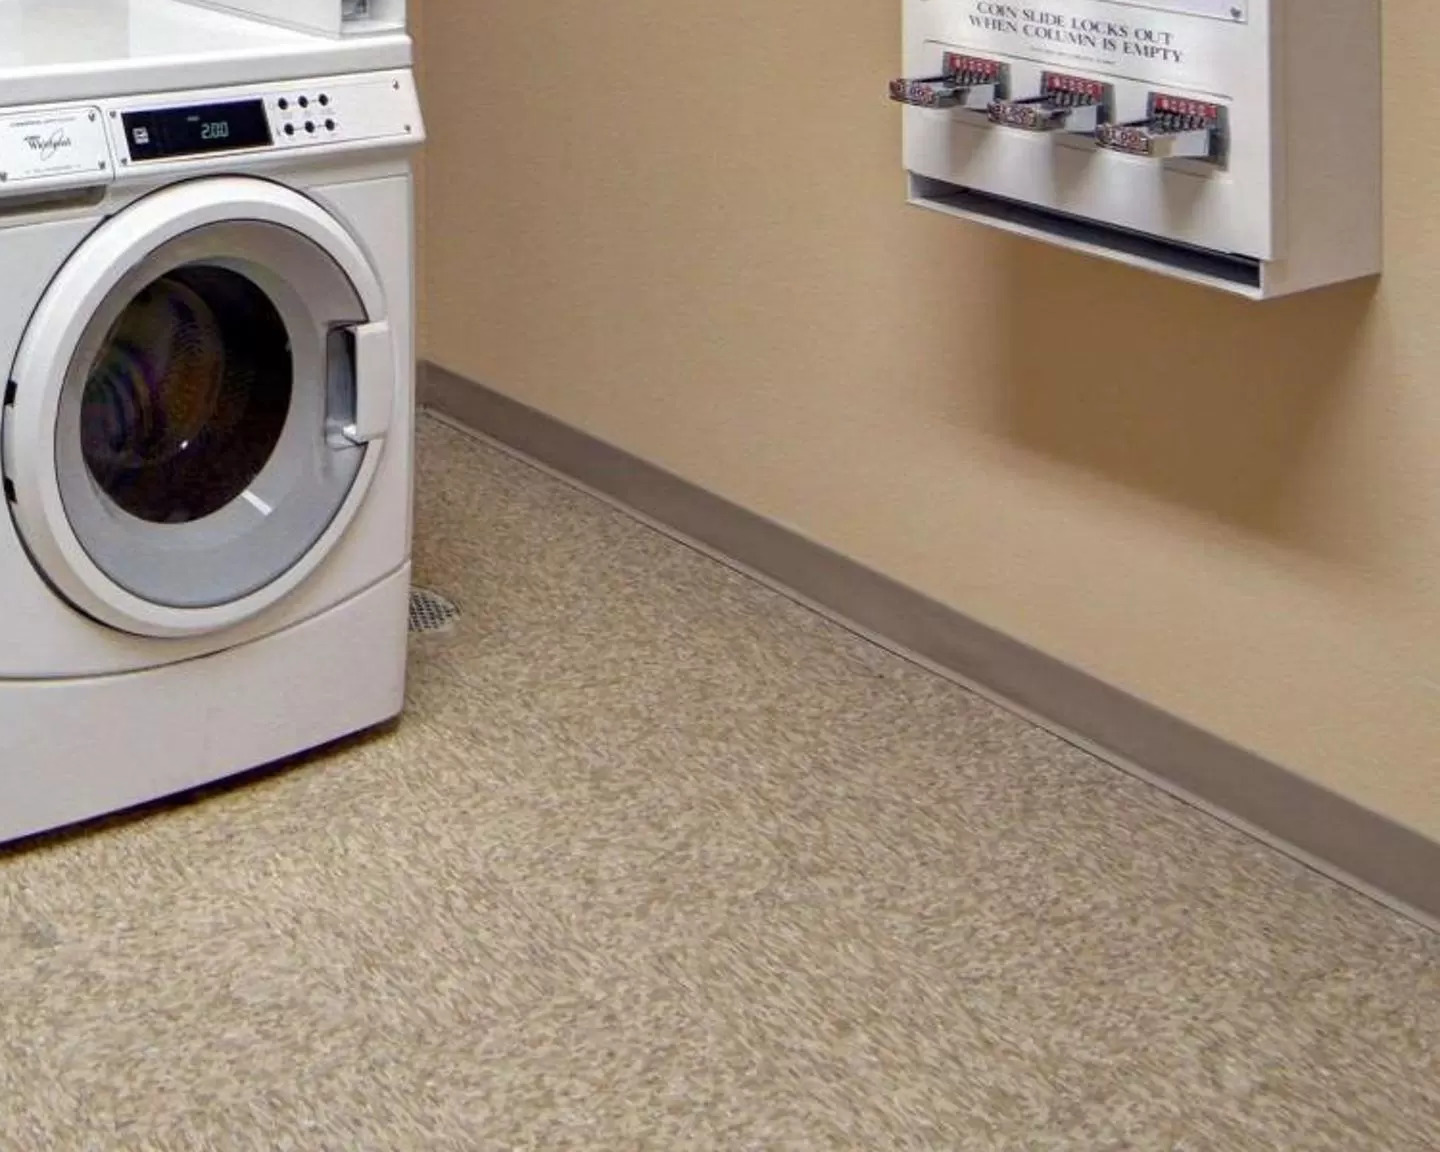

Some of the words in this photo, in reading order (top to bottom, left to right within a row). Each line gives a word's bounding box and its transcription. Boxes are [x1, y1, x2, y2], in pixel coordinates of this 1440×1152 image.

[968, 14, 1018, 33] WHEN
[1022, 24, 1097, 49] COLUMN
[1102, 38, 1117, 52] IS
[1122, 41, 1184, 64] EMPTY
[976, 1, 1018, 19] COIN
[1022, 9, 1066, 28] SLIDE
[1071, 17, 1128, 38] LOCKS
[1134, 28, 1174, 46] OUT
[200, 121, 230, 140] 2.00
